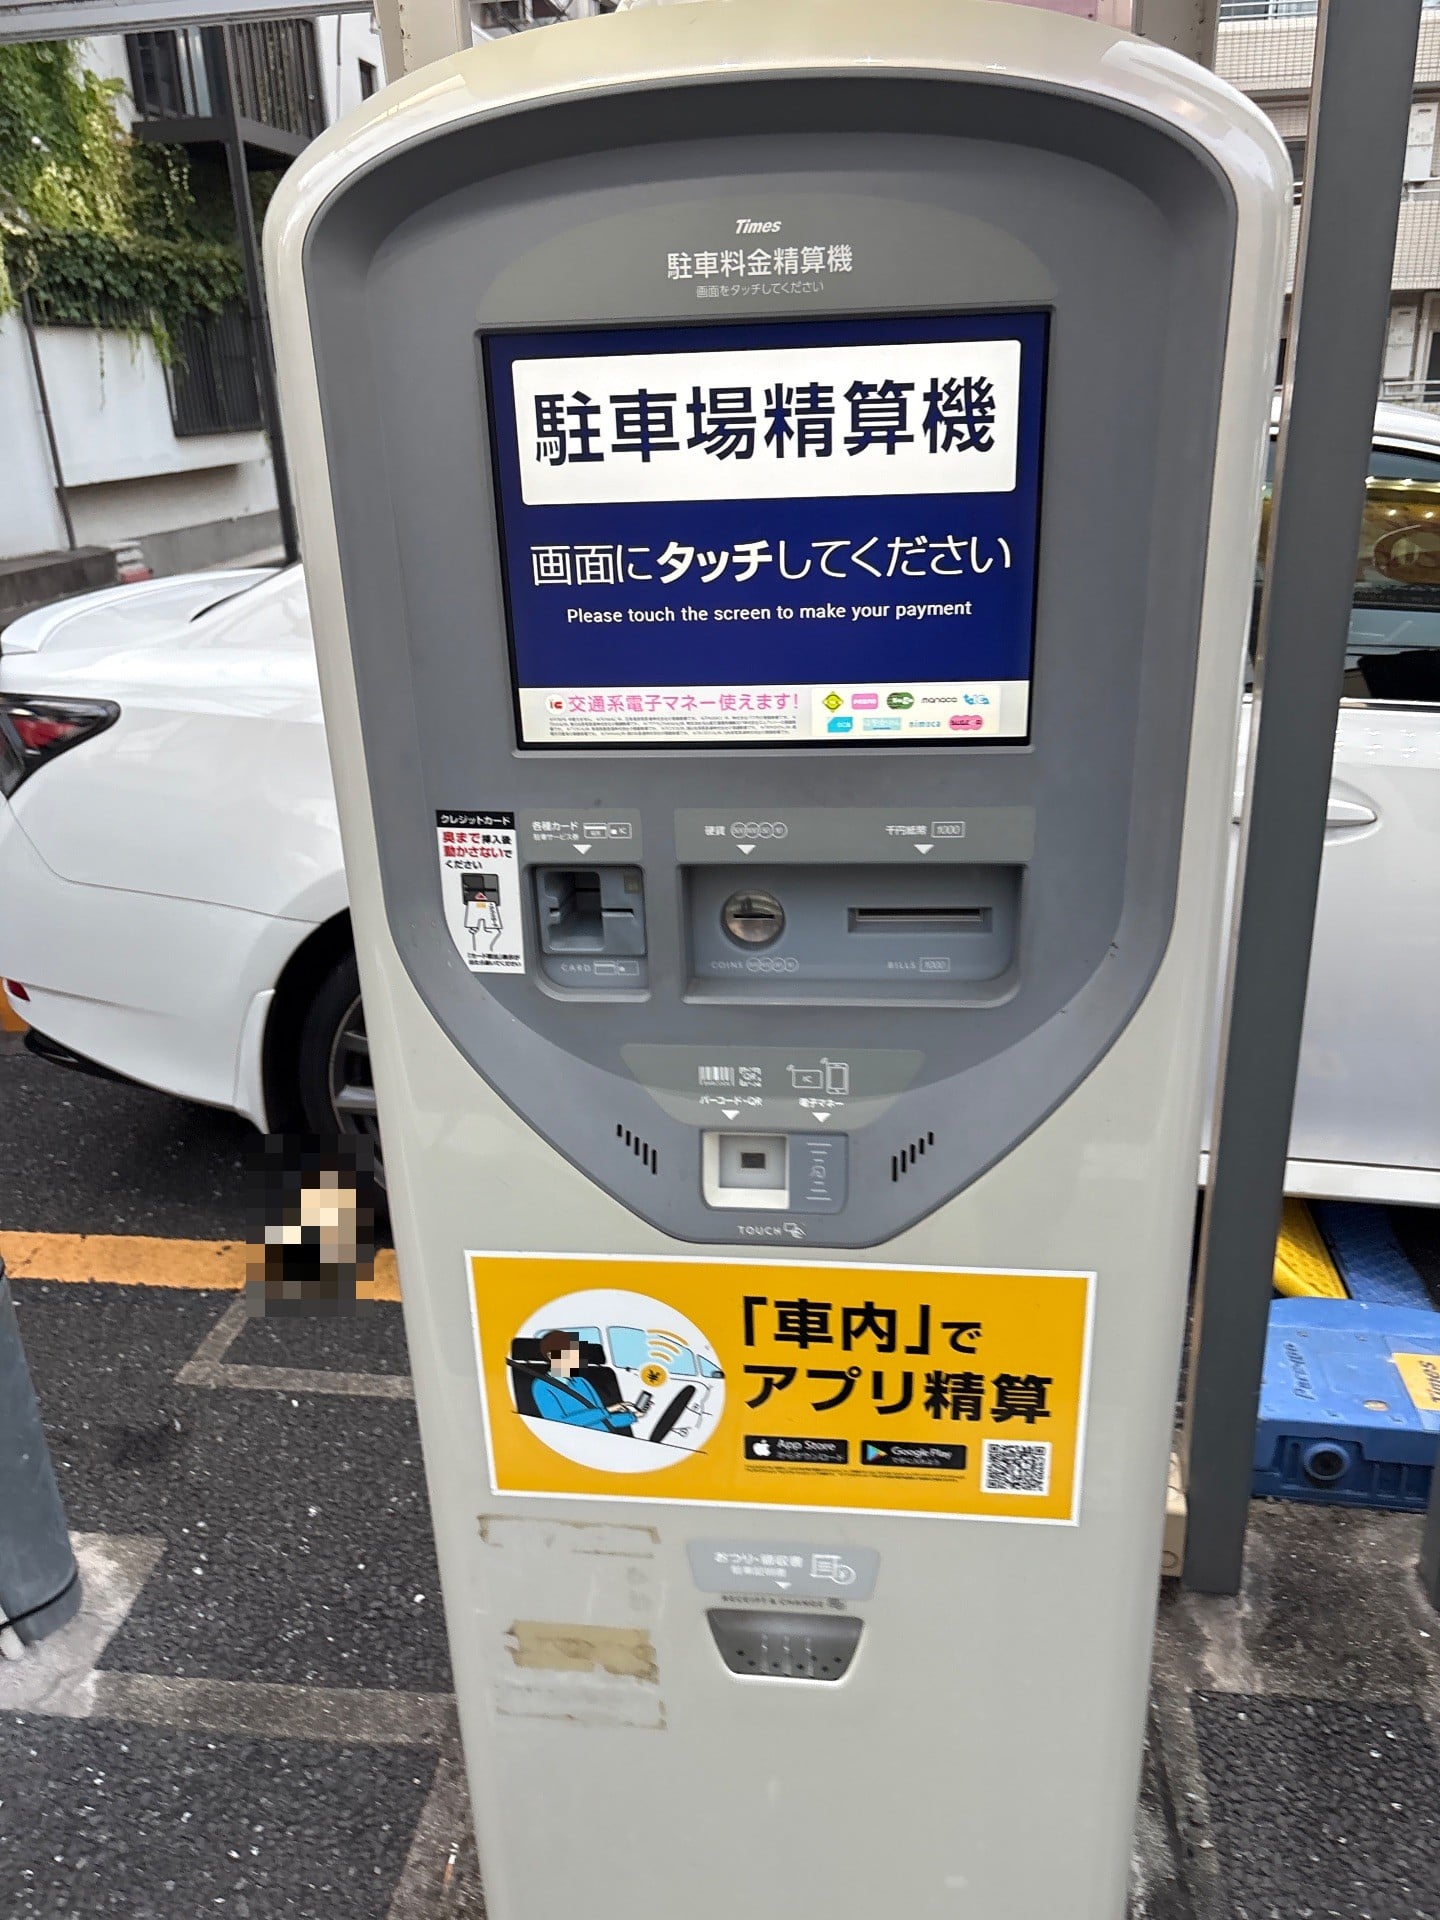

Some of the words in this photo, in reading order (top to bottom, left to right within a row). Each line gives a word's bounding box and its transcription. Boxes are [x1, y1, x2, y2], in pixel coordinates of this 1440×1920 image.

[735, 218, 782, 234] Times
[667, 244, 853, 280] 駐車料金精算機
[696, 281, 824, 299] 画面をタッチしてください
[534, 375, 996, 467] 駐車場精算機
[530, 534, 1011, 587] 画面にタッチしてください
[568, 608, 622, 622] Please
[628, 607, 675, 622] touch
[681, 606, 709, 621] the
[714, 609, 770, 620] screen
[776, 606, 793, 619] to
[800, 603, 846, 619] make
[852, 606, 890, 622] your
[896, 602, 972, 620] payment
[440, 814, 511, 826] クレジットカード
[445, 859, 483, 869] ください
[736, 1225, 782, 1236] TOUCH
[743, 1295, 982, 1356] 「車内」で
[743, 1364, 1053, 1425] アプリ精算
[776, 1438, 803, 1452] App
[804, 1440, 837, 1452] Store
[890, 1446, 931, 1459] Google
